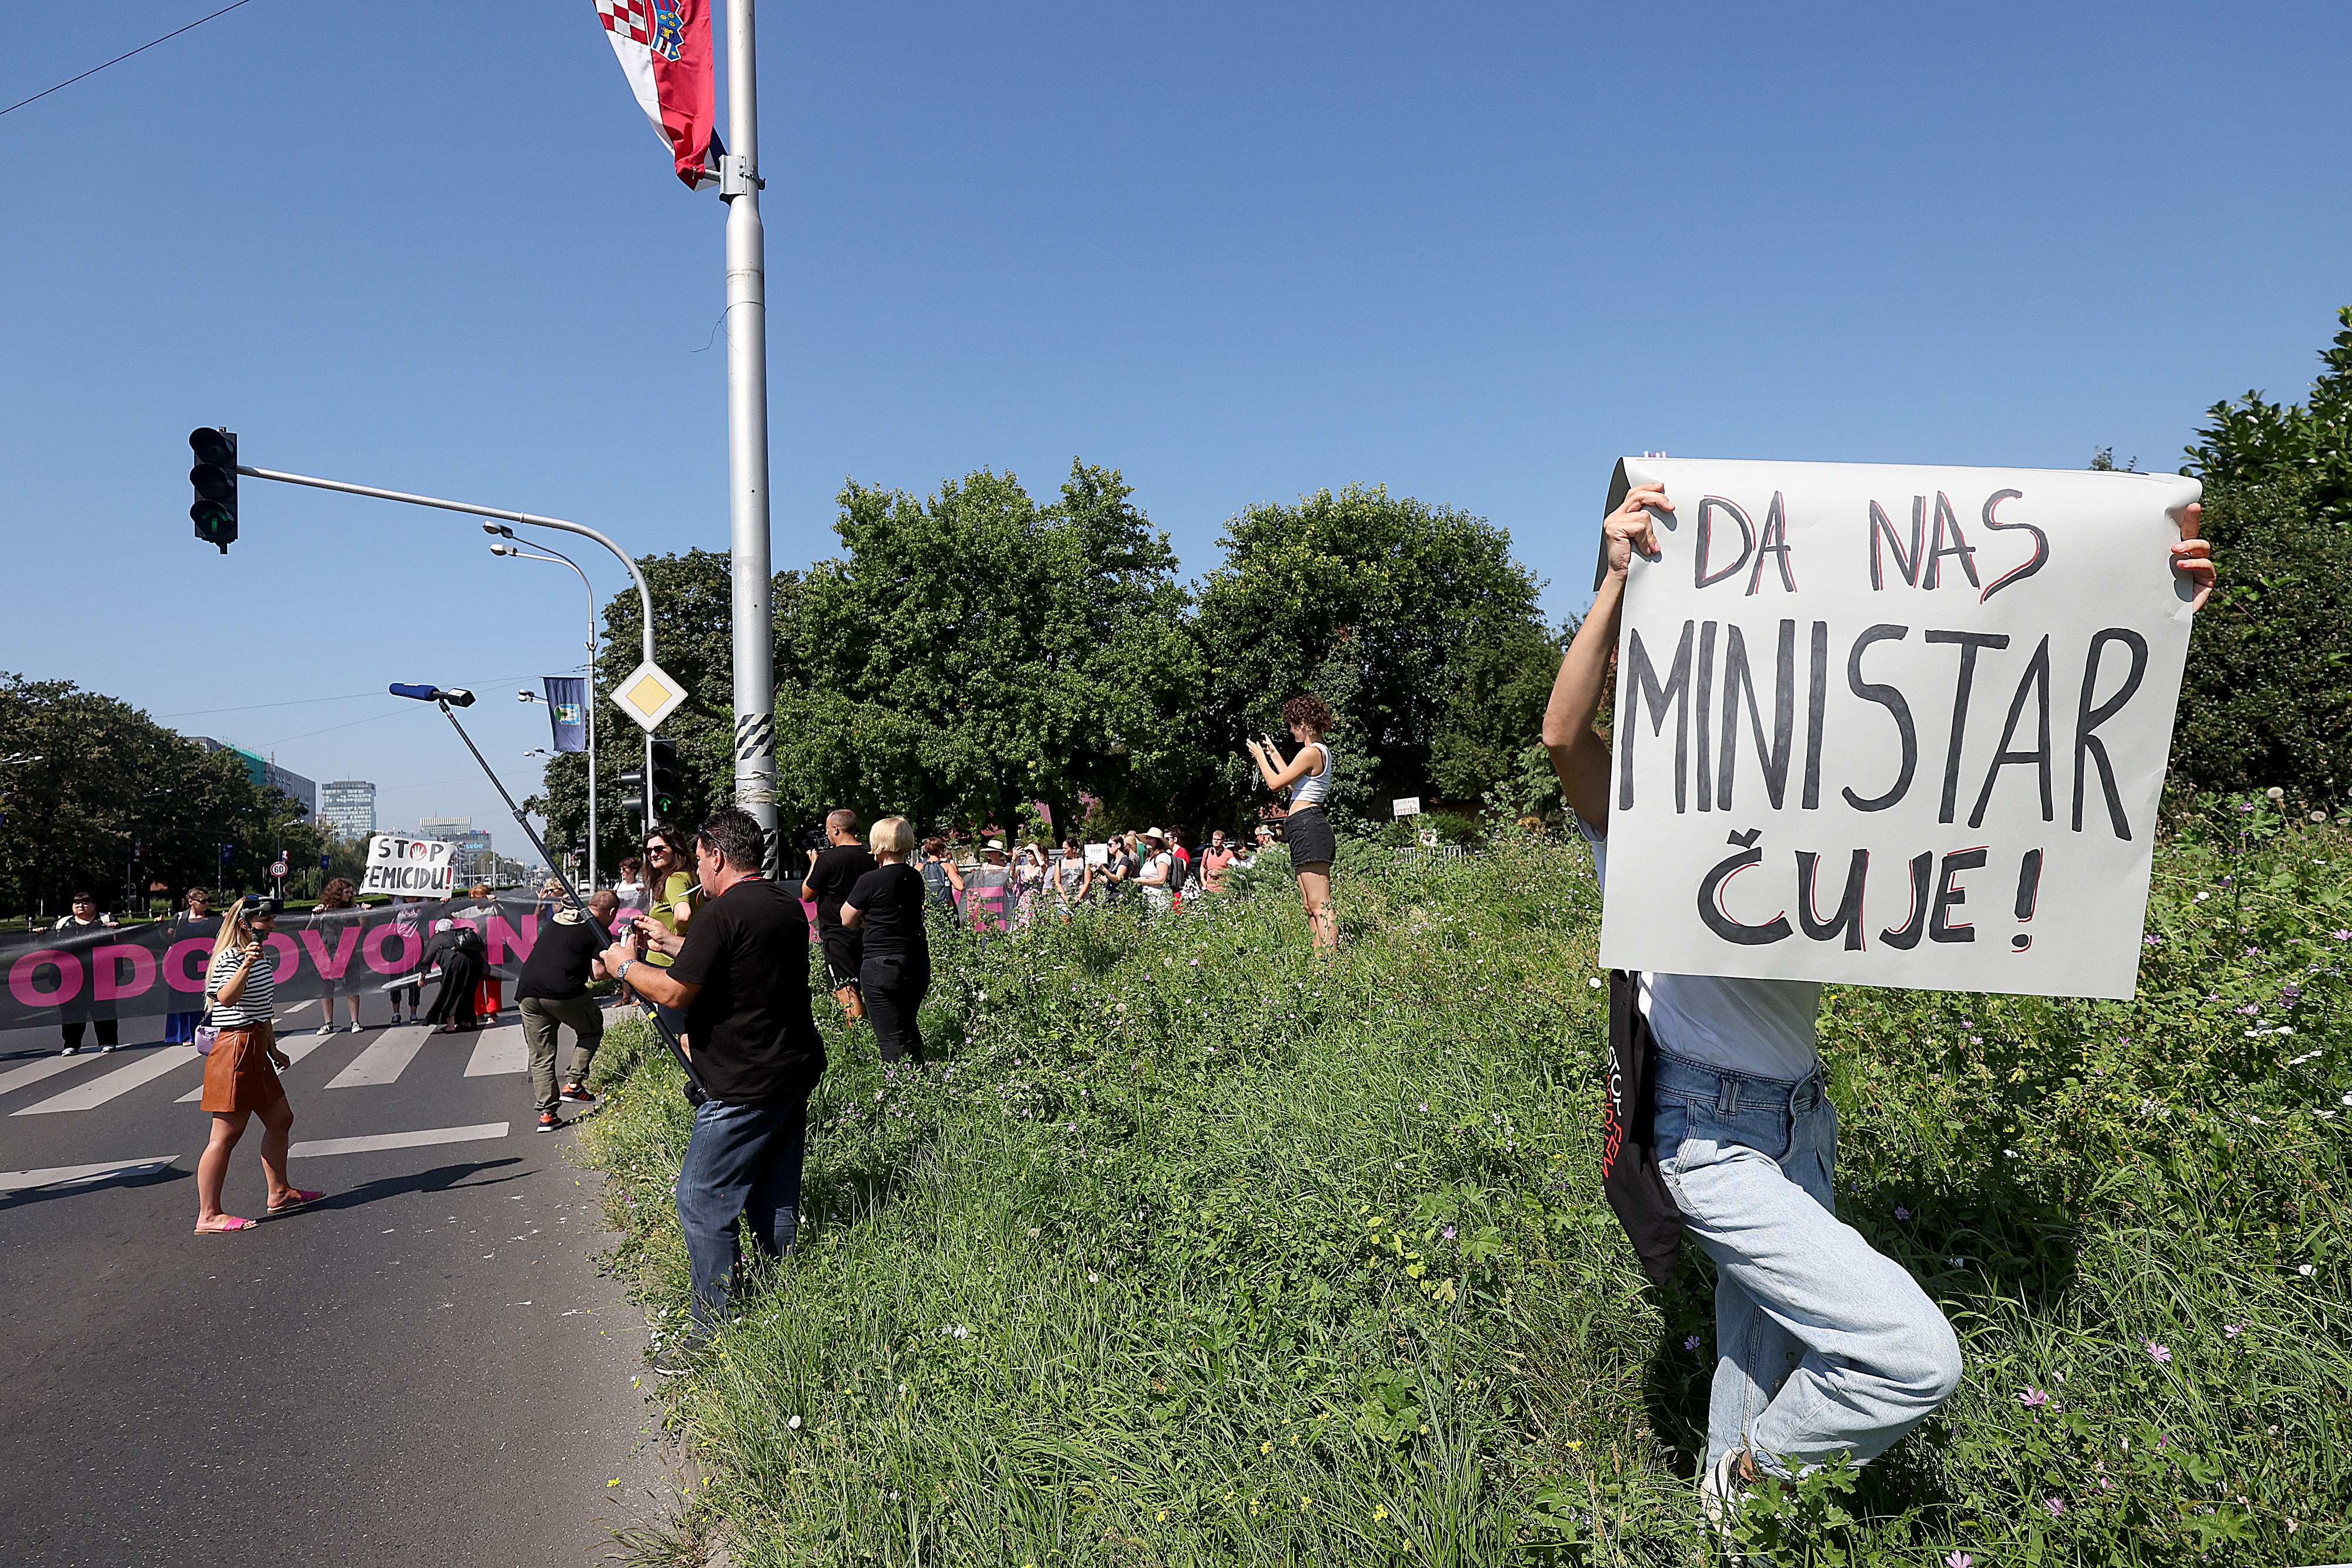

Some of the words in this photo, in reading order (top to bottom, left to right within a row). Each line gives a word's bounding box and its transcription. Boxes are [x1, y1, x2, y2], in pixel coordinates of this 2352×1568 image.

[1694, 490, 1798, 597] DA
[1869, 488, 2050, 605] NAS
[1618, 618, 2149, 841] MINISTAR
[377, 838, 445, 862] STOP
[1696, 828, 2044, 953] ČUJE!
